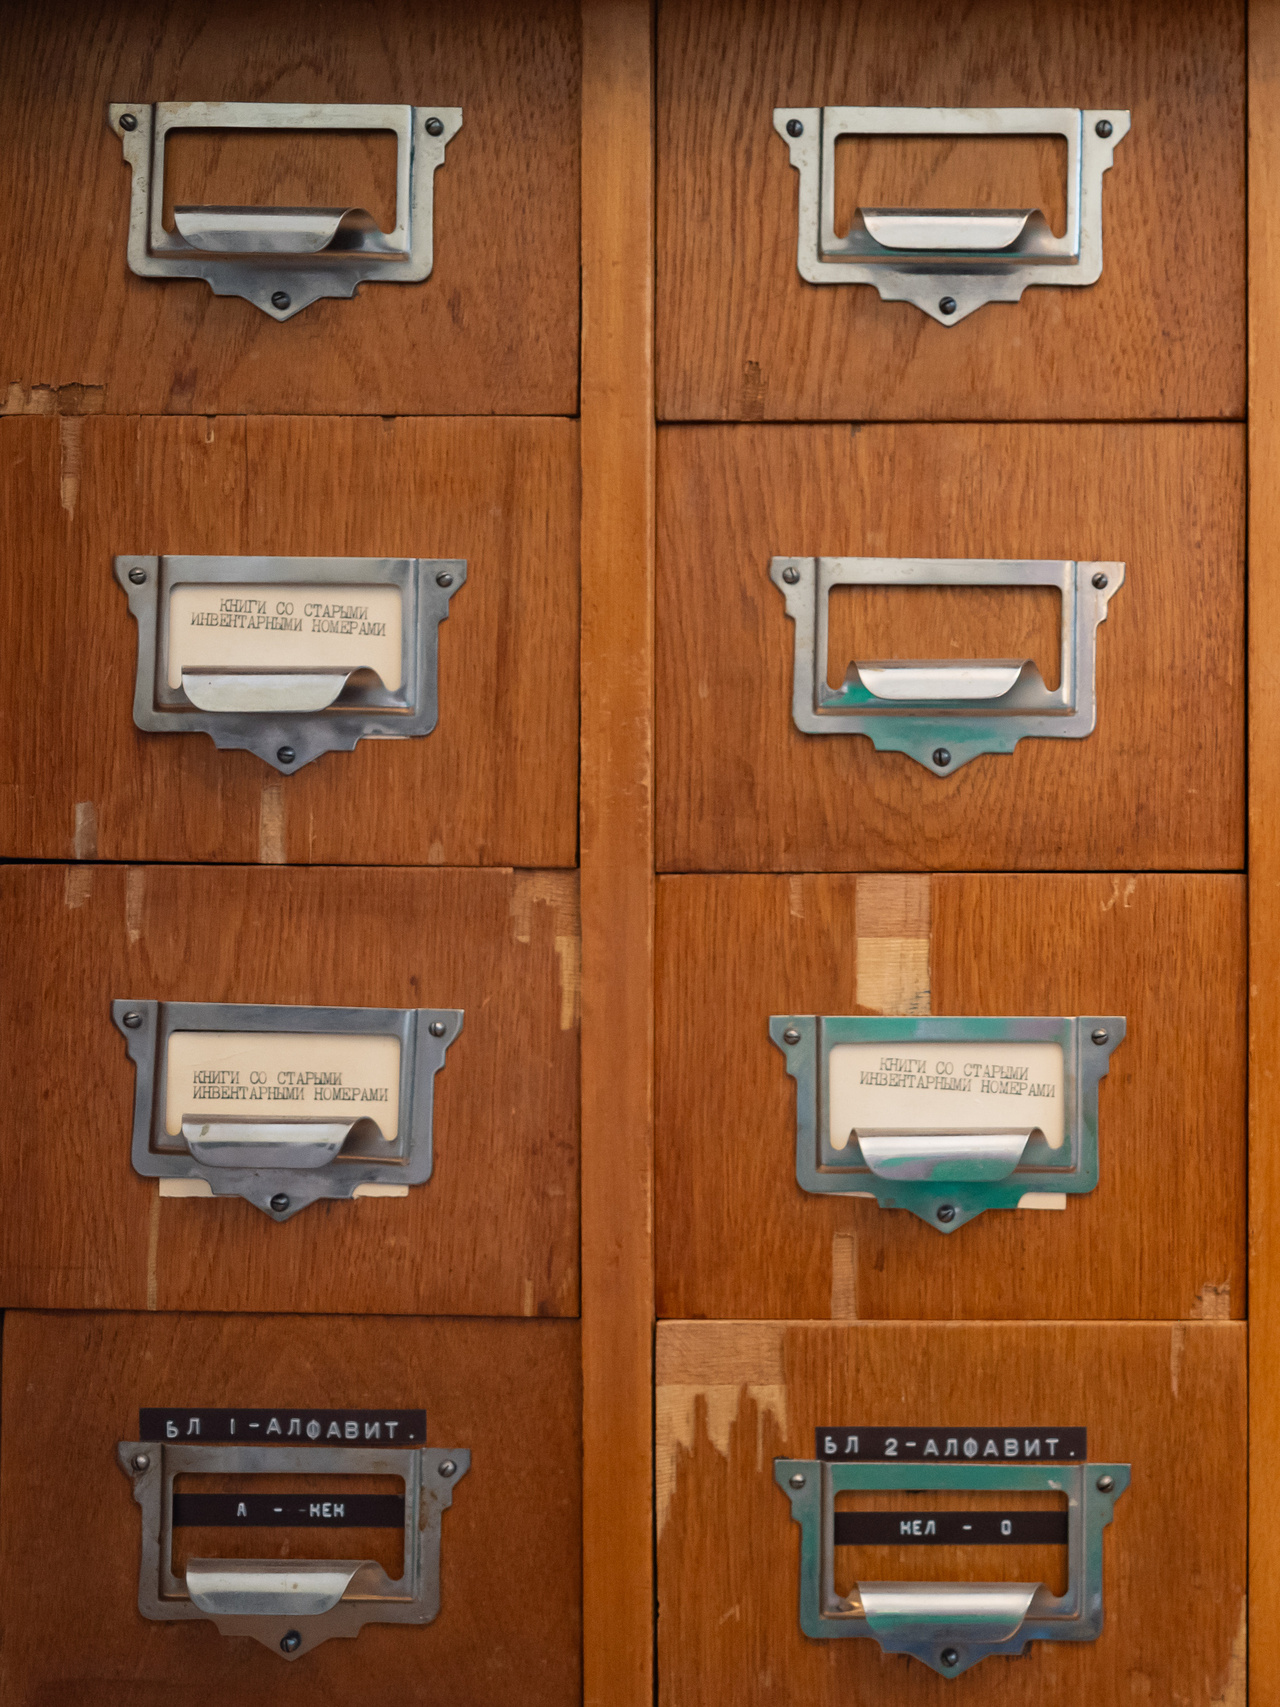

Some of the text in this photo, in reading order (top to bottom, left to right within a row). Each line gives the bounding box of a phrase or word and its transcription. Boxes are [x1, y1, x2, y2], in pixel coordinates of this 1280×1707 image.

[220, 598, 368, 620] КНИГИ СО СТАРЫМИ
[190, 612, 386, 636] ИНВЕНТАРНЫМИ НОМЕРАМИ
[193, 1070, 343, 1086] КНИГИ СО СТАРЫМИ
[879, 1057, 1030, 1081] КНИГИ СО СТАРЫМИ
[193, 1086, 389, 1102] ИНВЕНТАРНЫМИ НОМЕРАМИ
[860, 1071, 1056, 1098] ИНВЕНТАРНЫМИ НОМЕРАМИ
[165, 1418, 201, 1438] БЛ
[824, 1436, 1075, 1458] БЛ 2-АЛФАВИТ.
[237, 1502, 247, 1517] А
[900, 1520, 936, 1536] КЕЛ
